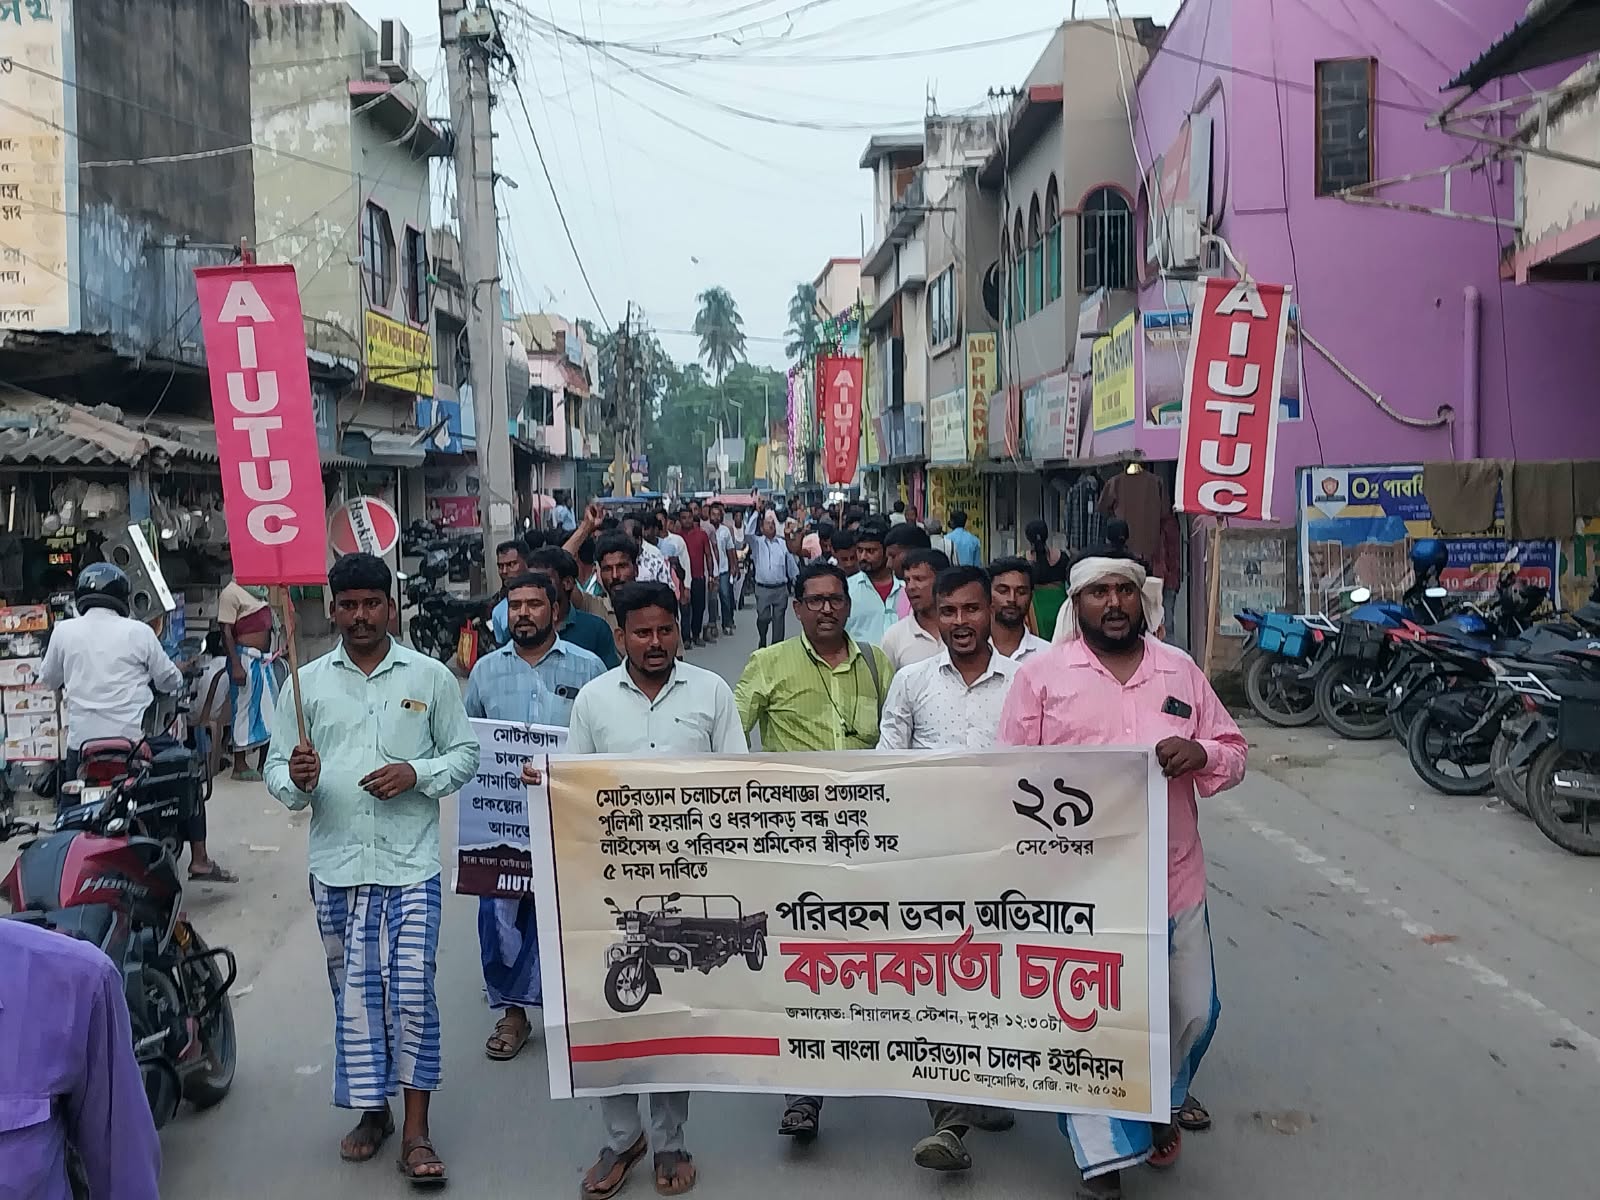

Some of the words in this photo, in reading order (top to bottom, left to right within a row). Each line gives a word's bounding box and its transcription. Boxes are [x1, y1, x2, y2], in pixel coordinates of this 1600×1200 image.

[217, 281, 300, 545] AIUTUC
[1198, 284, 1268, 513] AIUTUC
[349, 500, 375, 555] Hawkin
[494, 725, 559, 748] মোটরভ্যান
[476, 771, 528, 791] সামাজি
[596, 785, 676, 808] মোটরভ্যান
[680, 786, 742, 805] চলাচলে
[746, 780, 819, 804] নিষেধাজ্ঞা
[472, 795, 522, 815] প্রকল্পের
[1012, 777, 1094, 832] ২৯
[599, 808, 644, 837] পুলিশী
[648, 808, 703, 833] হয়রানি
[709, 813, 722, 829] ও
[728, 811, 796, 833] ধরপাকড়
[800, 810, 829, 828] বন্ধ
[834, 809, 869, 827] এবং
[600, 836, 661, 856] লাইসেন্স
[666, 839, 679, 854] ও
[685, 832, 748, 856] পরিবহন
[753, 831, 817, 854] শ্রমিকের
[822, 829, 870, 858] স্বীকৃতি
[874, 834, 899, 853] সহ
[1016, 834, 1094, 857] সেপ্টেম্বর
[603, 863, 616, 880] ৫
[622, 862, 655, 880] দফা
[659, 857, 708, 880] দাবিতে
[775, 891, 889, 931] পরিবহন
[898, 901, 965, 931] ভবন
[974, 889, 1095, 936] অভিযানে
[1016, 943, 1123, 1032] চলো
[849, 1003, 912, 1023] শিয়ালদহ
[916, 1005, 963, 1025] স্টেশন,
[967, 1010, 998, 1029] দুপুর
[1005, 1012, 1062, 1033] ১২:৩০টা
[788, 1038, 825, 1060] সারা
[831, 1040, 880, 1061] বাংলা
[887, 1036, 981, 1067] মোটরভ্যান
[987, 1045, 1041, 1072] চালক
[1047, 1047, 1124, 1080] ইউনিয়ন
[912, 1065, 970, 1082] AIUTUC
[974, 1073, 1029, 1091] অনুমোদিত,
[1033, 1076, 1062, 1092] রেজি.
